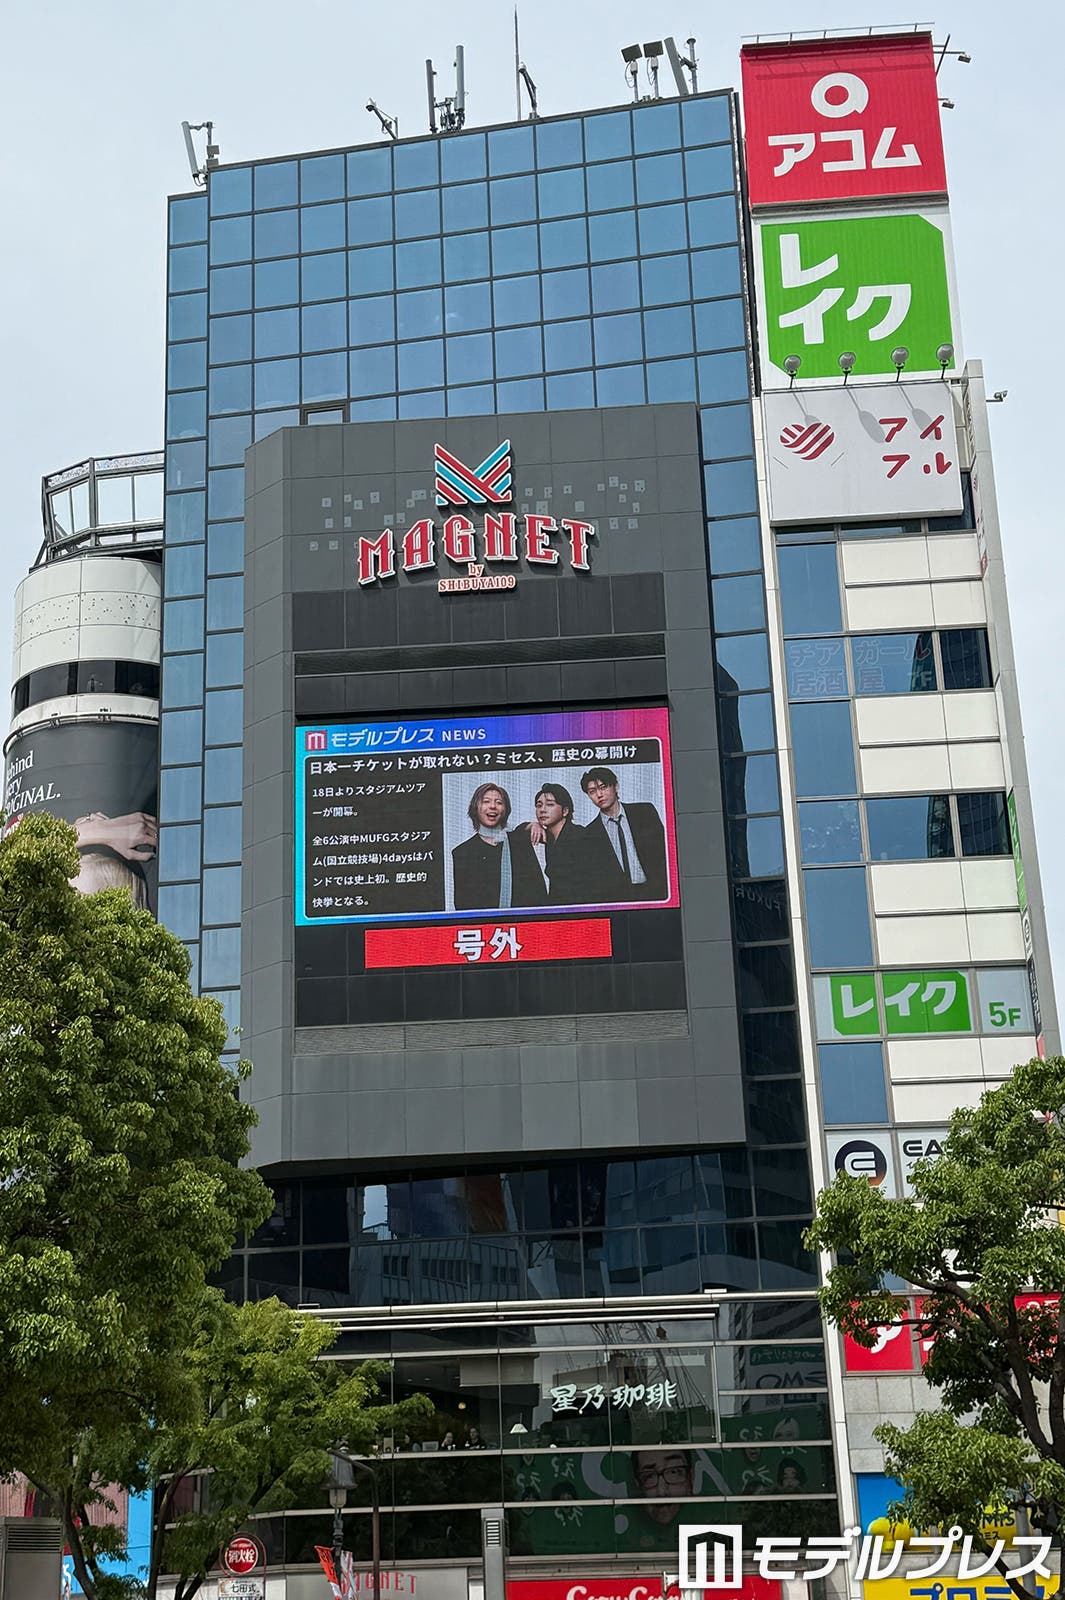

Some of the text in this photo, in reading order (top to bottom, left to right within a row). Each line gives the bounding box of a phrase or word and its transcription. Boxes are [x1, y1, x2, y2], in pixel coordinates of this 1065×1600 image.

[768, 127, 922, 177] アコム
[357, 512, 595, 585] MAGNET
[468, 562, 484, 578] by
[438, 575, 516, 594] SHIBUYA109
[331, 726, 486, 747] モデルプレス NEWS
[312, 783, 426, 798] 18日よりスタジアムツア
[312, 831, 431, 846] 全6公演中MUFGスタジア
[453, 926, 523, 963] 号外
[840, 980, 957, 1019] レイク
[989, 1001, 1022, 1027] 5F
[550, 1379, 677, 1414] 星乃珈琲
[228, 1548, 255, 1564] 消火栓
